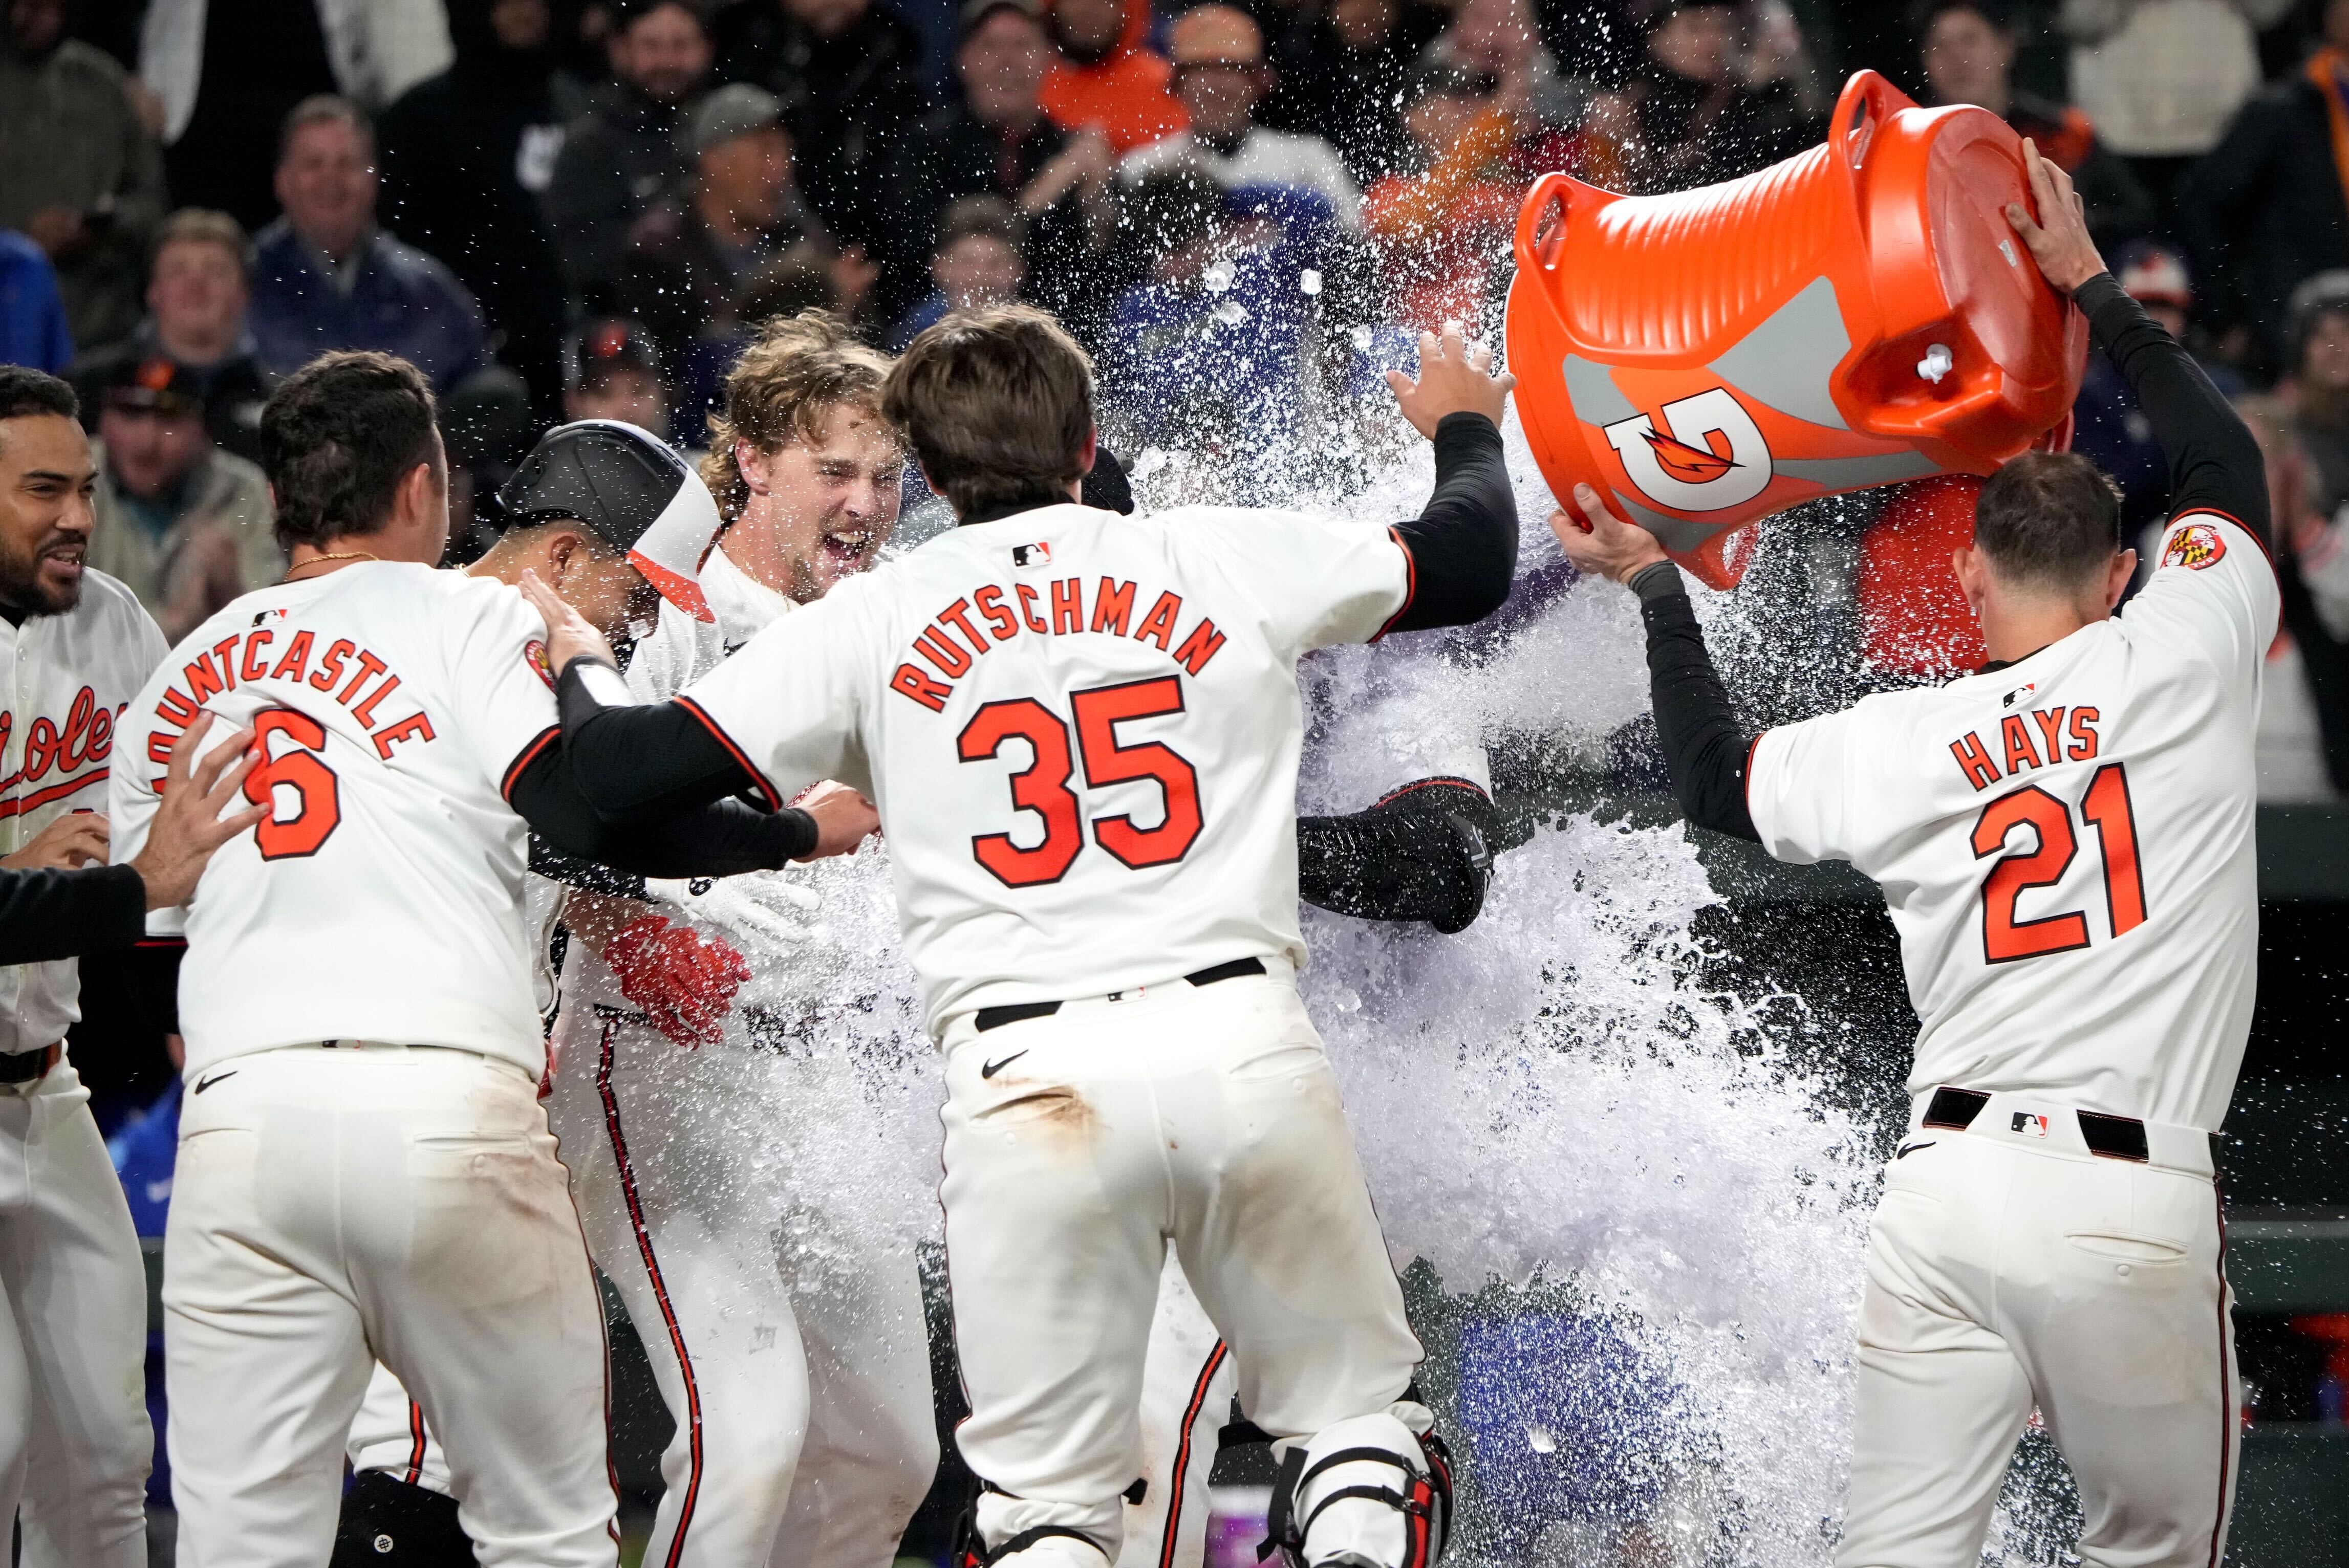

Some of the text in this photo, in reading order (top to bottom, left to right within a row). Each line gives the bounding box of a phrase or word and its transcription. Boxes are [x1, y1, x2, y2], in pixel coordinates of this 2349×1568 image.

[1603, 386, 1773, 511] G
[148, 630, 437, 795] OUNTCASTLE
[890, 576, 1227, 714] RUTSCHMAN
[242, 707, 341, 862] 6
[957, 674, 1204, 889] 35
[1949, 706, 2100, 792] HAYS
[1969, 761, 2148, 965] 21
